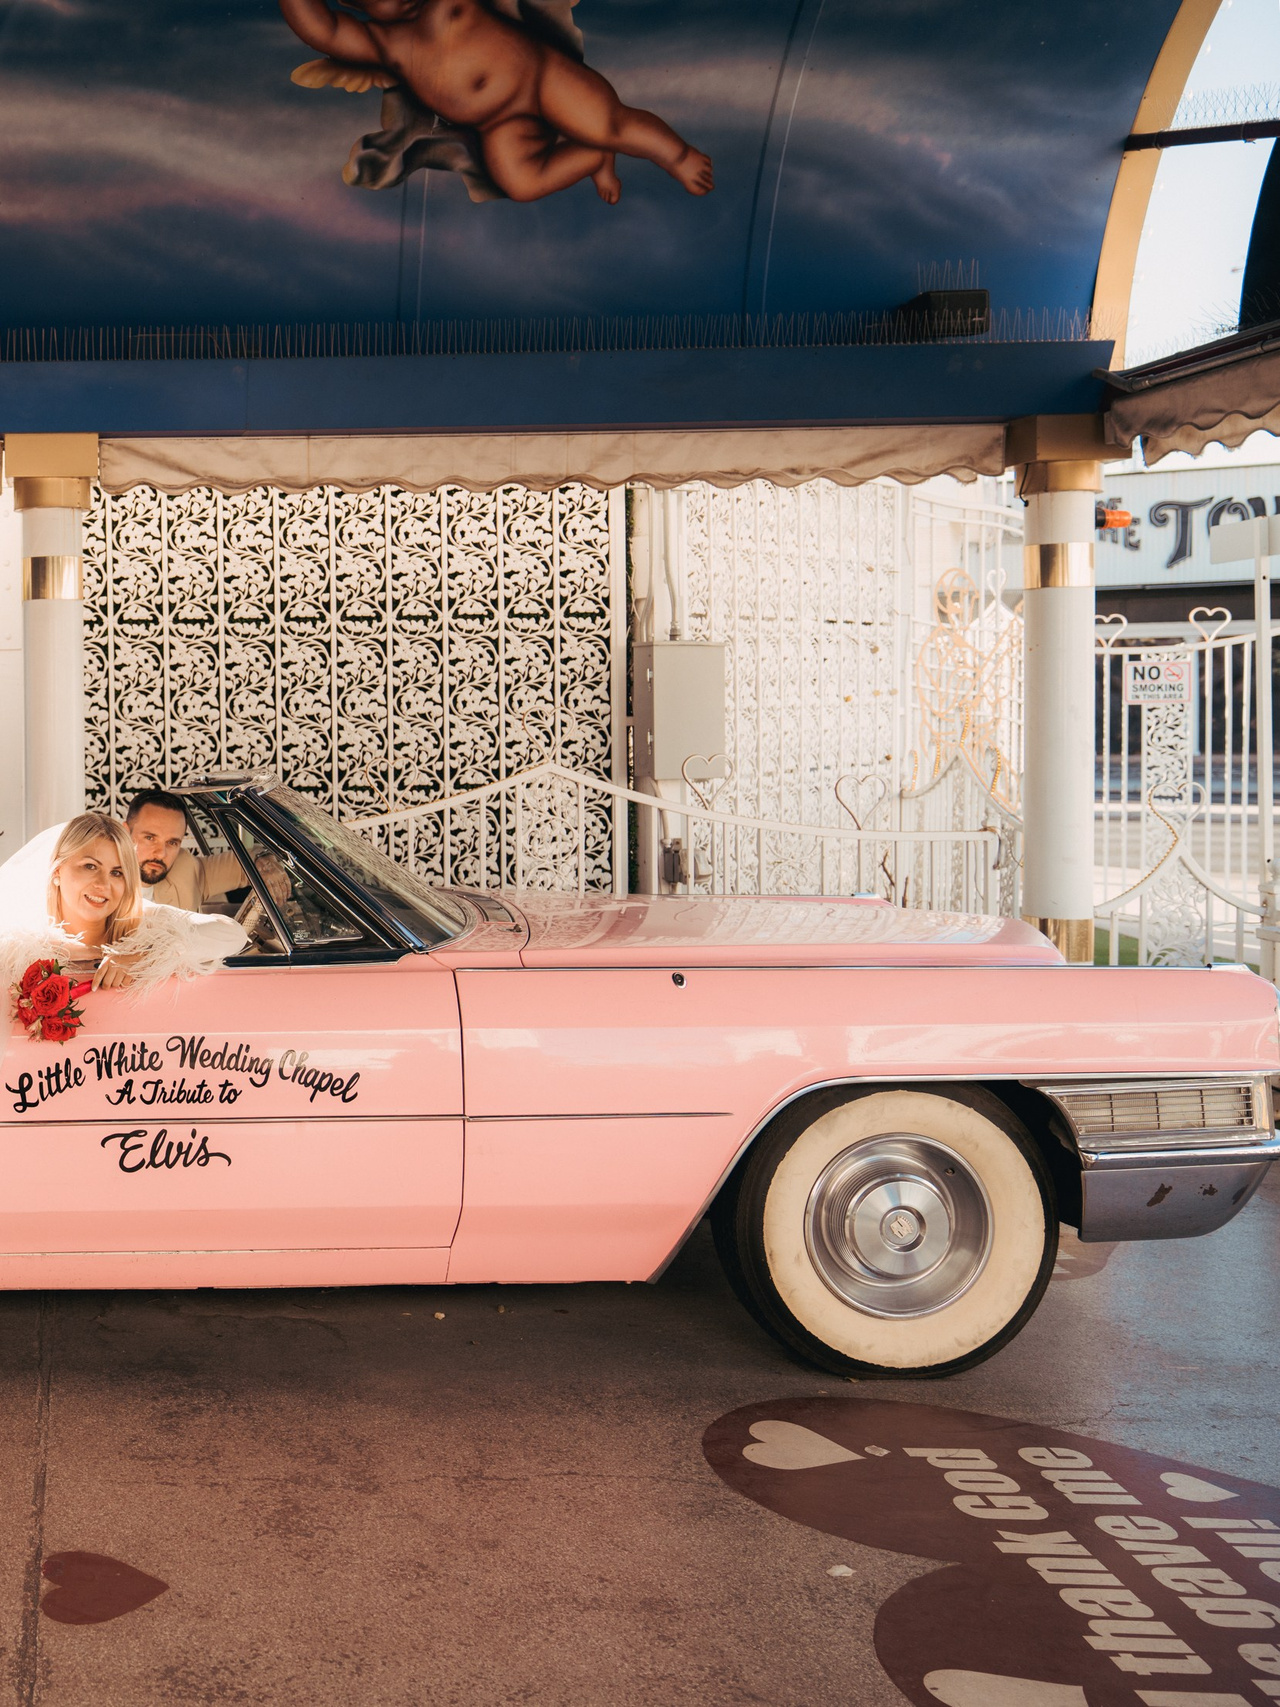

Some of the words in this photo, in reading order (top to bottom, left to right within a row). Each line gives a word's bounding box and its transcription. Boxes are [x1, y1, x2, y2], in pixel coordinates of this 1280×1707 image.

[1132, 683, 1184, 692] SMOKING
[1133, 666, 1160, 680] NO
[6, 1058, 86, 1113] Little
[84, 1041, 163, 1080] White
[166, 1035, 274, 1087] Wedding
[278, 1049, 361, 1103] Chapel
[105, 1079, 136, 1105] A
[140, 1078, 214, 1105] Tribute
[218, 1079, 242, 1105] to
[101, 1128, 232, 1173] Elvis
[902, 1447, 1050, 1520] God
[1018, 1447, 1144, 1505] me
[1094, 1515, 1280, 1629] gave
[992, 1530, 1213, 1676] thank
